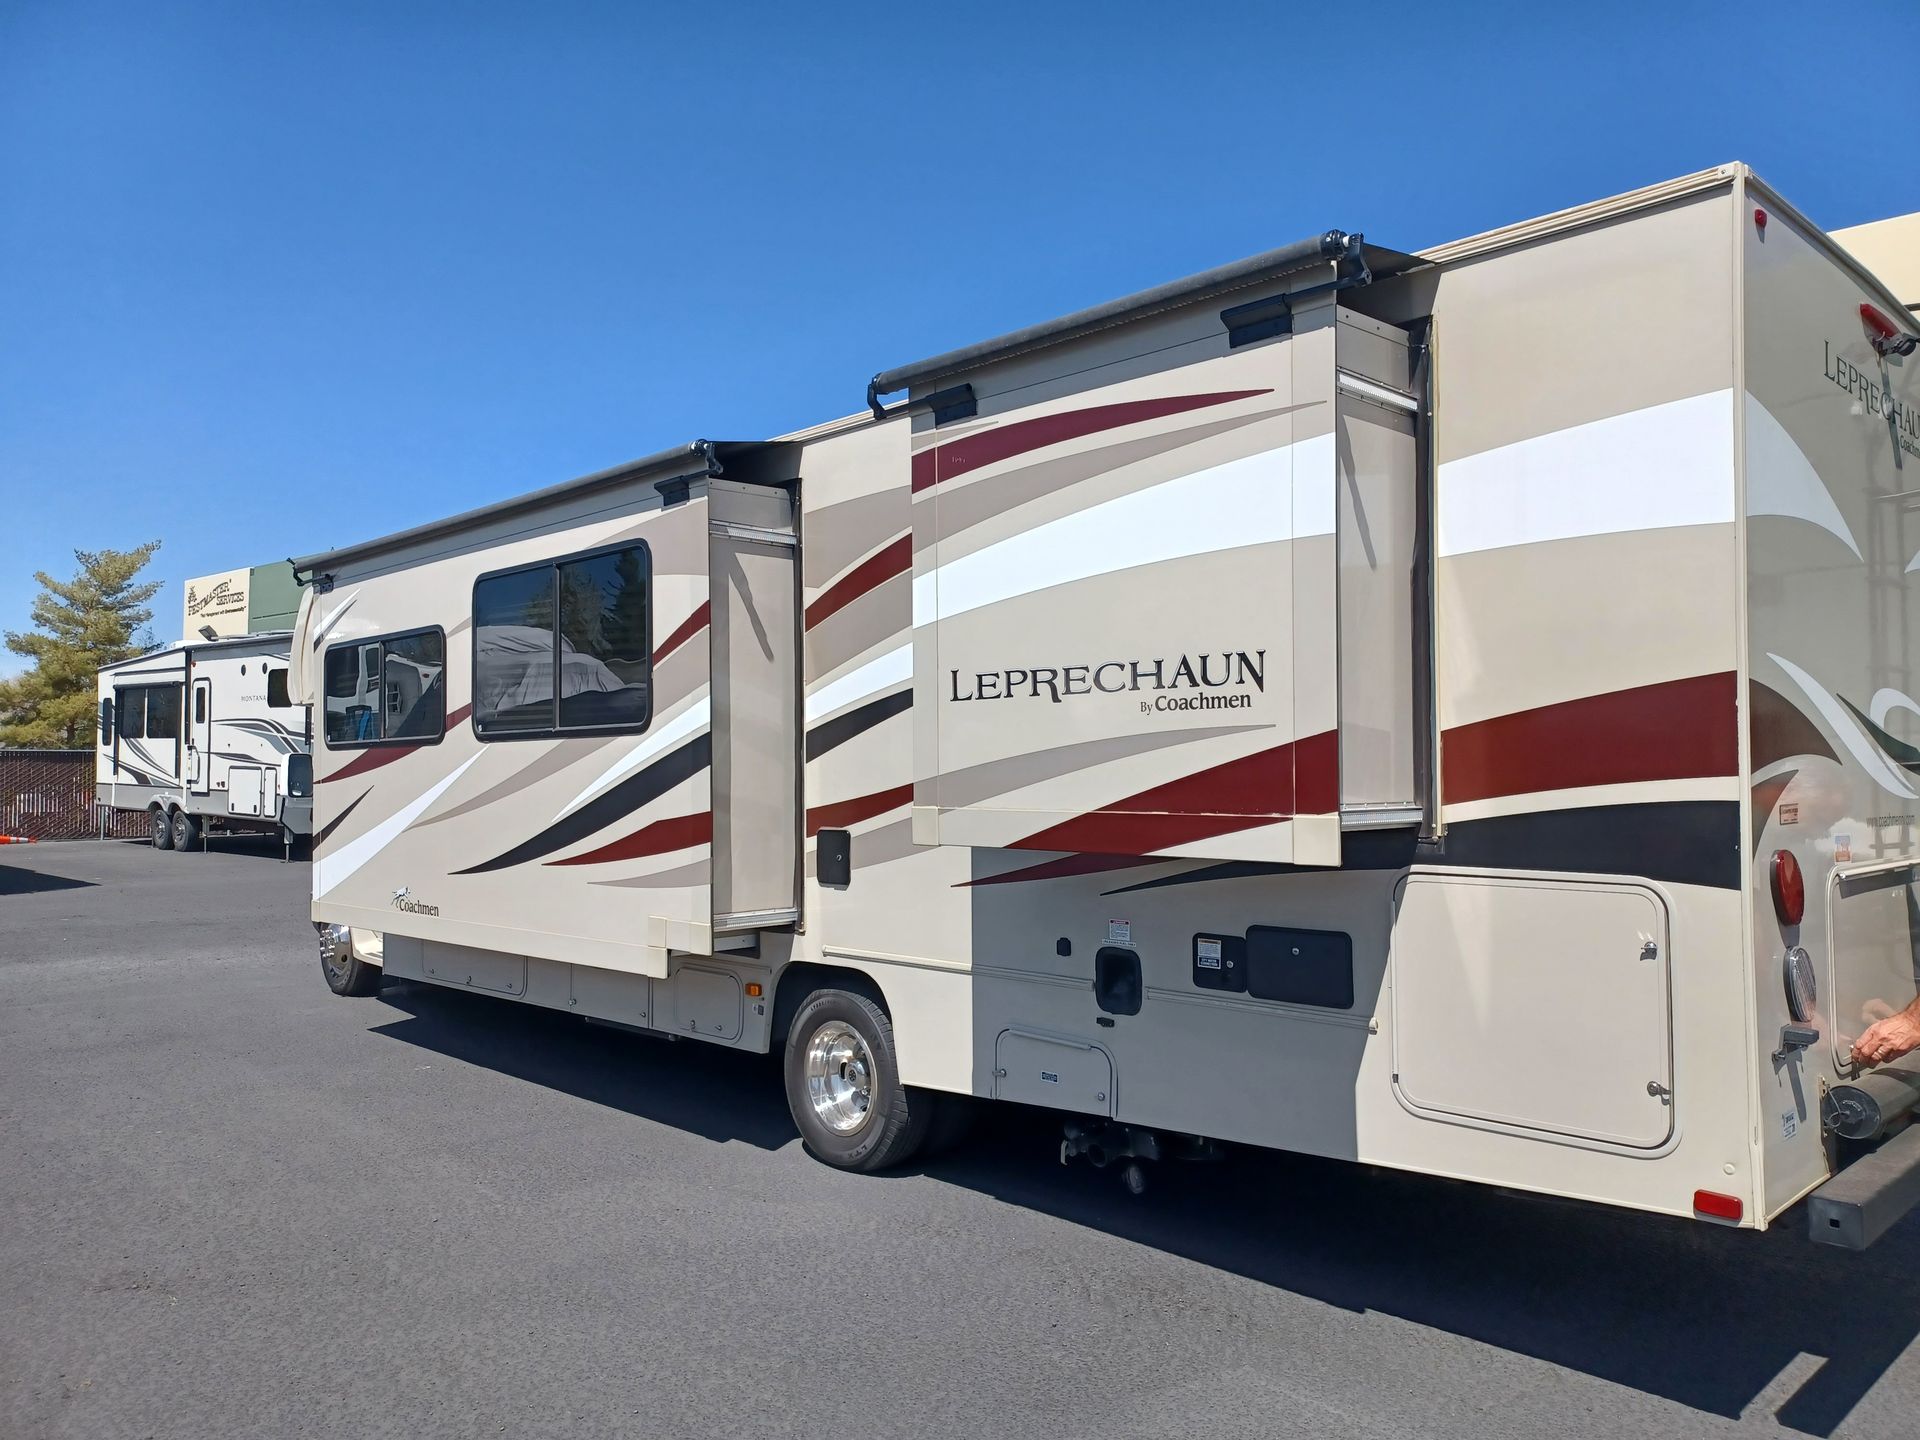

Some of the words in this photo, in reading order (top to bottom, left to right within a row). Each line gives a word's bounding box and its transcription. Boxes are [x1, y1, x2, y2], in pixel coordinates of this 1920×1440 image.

[216, 591, 244, 606] SERVICES
[949, 649, 1267, 703] LEPRECHAUN
[1140, 700, 1153, 715] By
[1154, 692, 1252, 712] Coachmen
[399, 898, 440, 917] Coachmen
